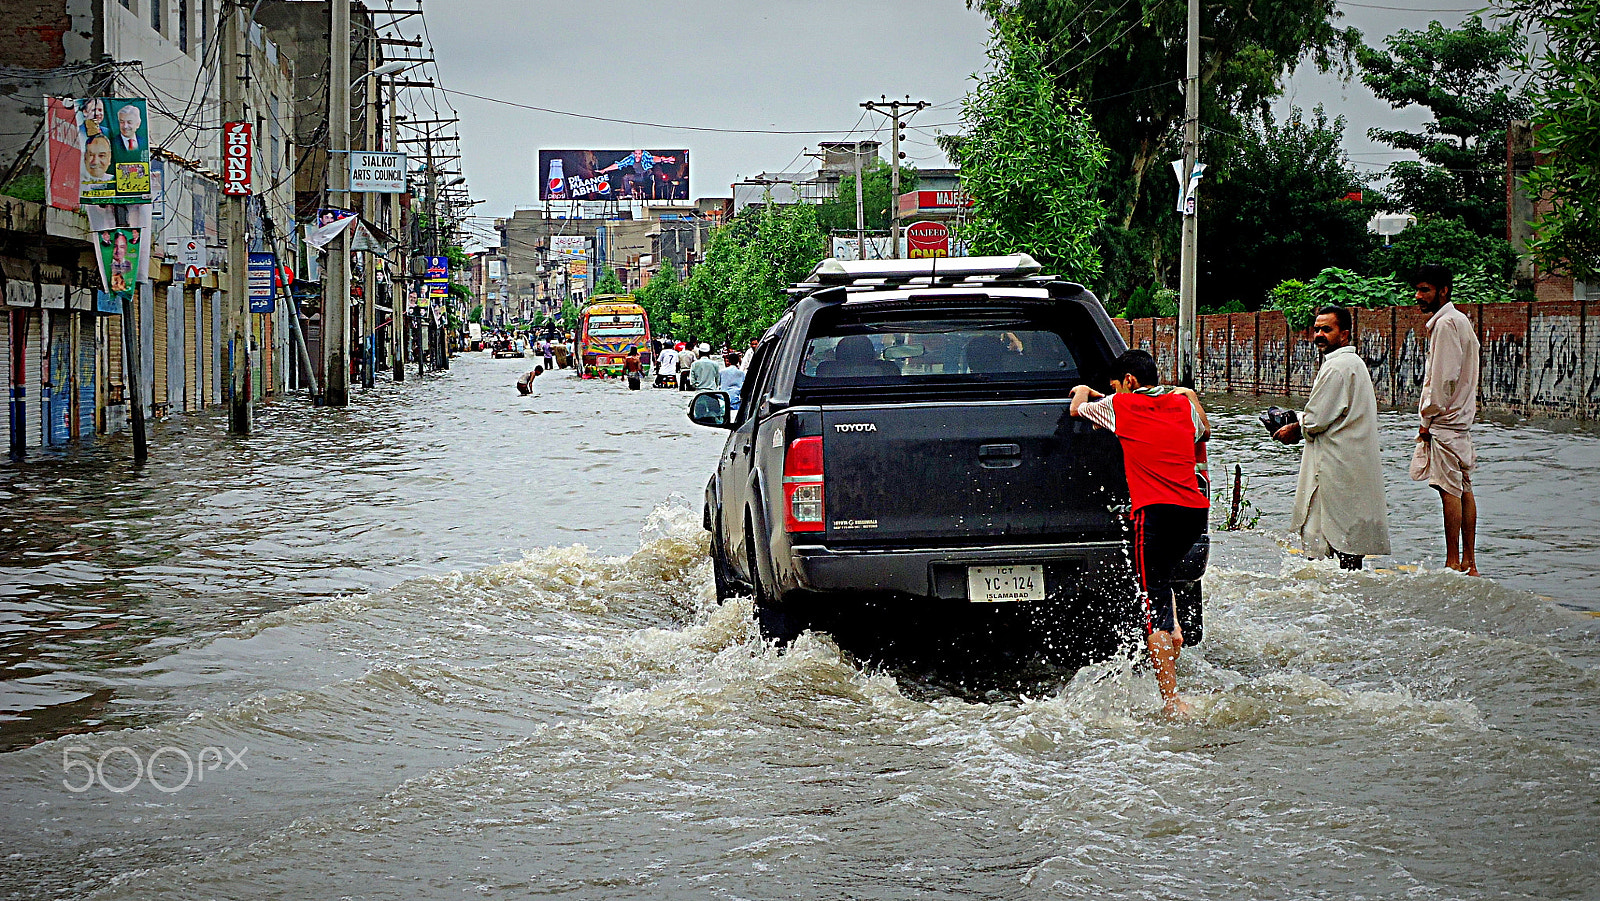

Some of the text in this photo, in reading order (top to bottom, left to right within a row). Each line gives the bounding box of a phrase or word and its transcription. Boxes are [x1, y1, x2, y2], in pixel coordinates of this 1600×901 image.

[227, 132, 248, 194] HONDA
[362, 155, 397, 168] SIALKOT
[352, 169, 404, 182] ARTS COUNCIL
[568, 175, 582, 184] DIL
[570, 174, 610, 191] MAANGE
[572, 183, 599, 198] ABHI
[910, 229, 946, 237] MAJEED
[910, 248, 947, 259] CNG
[834, 423, 877, 433] TOYOTA
[997, 567, 1014, 575] ICT
[984, 575, 1034, 591] YC 124
